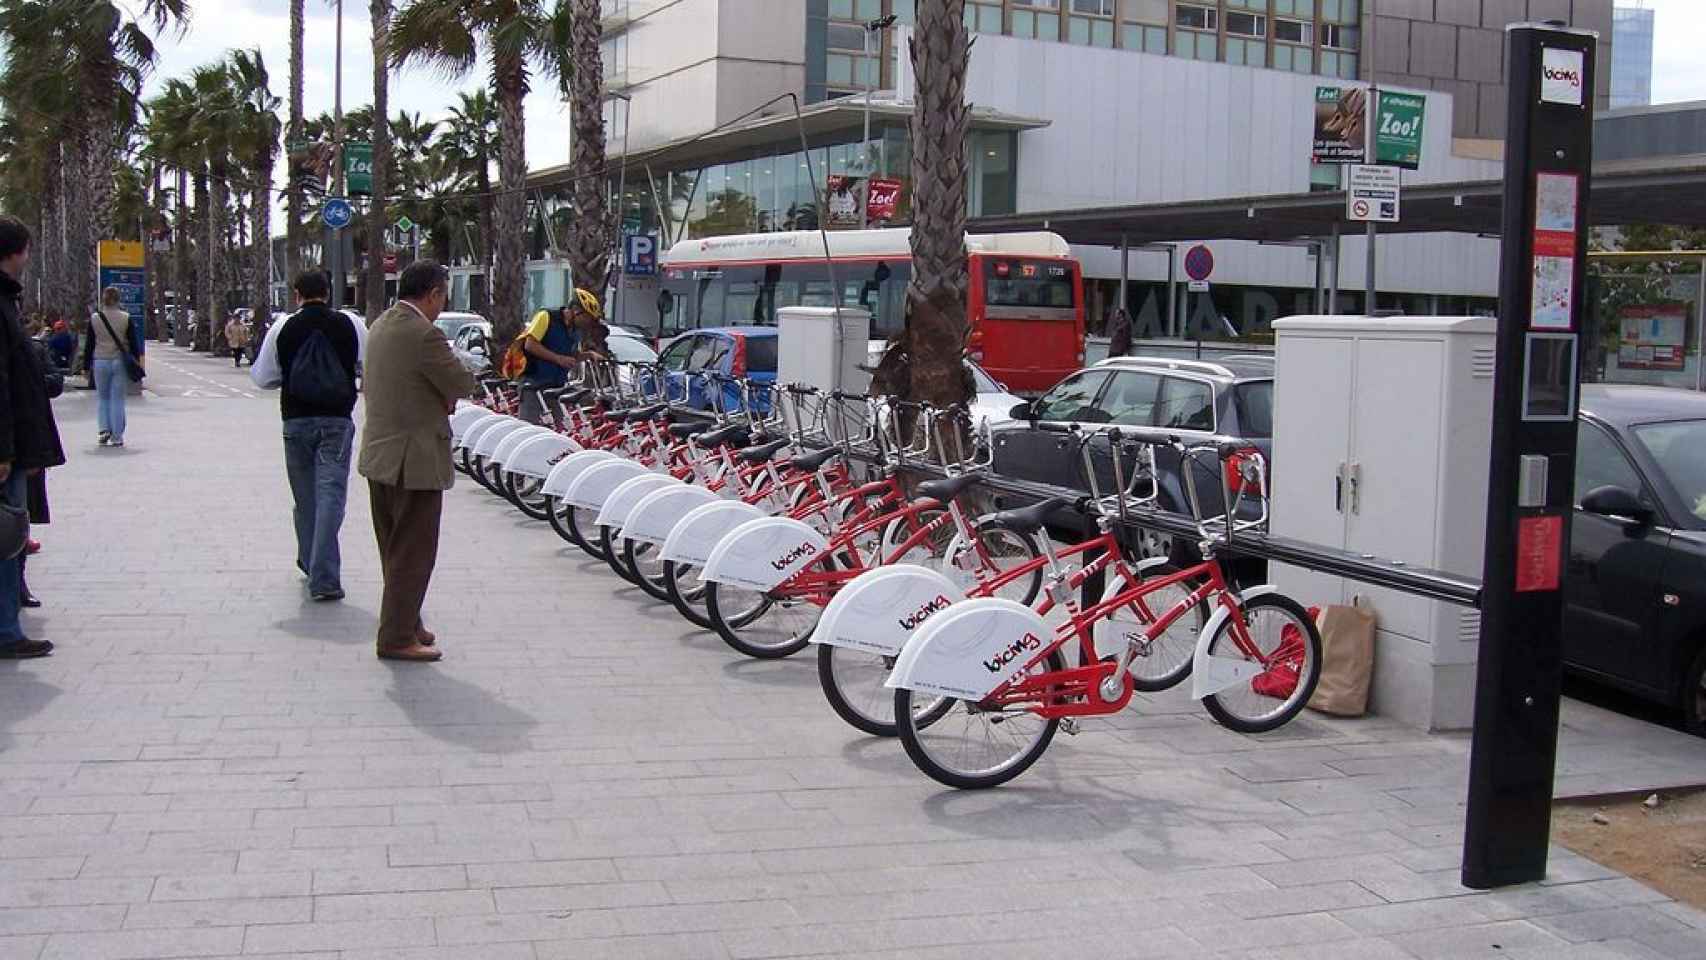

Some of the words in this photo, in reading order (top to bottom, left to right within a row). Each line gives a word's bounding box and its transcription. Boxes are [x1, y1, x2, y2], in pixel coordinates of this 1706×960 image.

[1543, 65, 1580, 87] bicing
[1379, 112, 1421, 137] Zoo!
[631, 236, 652, 264] P
[771, 541, 816, 570] bicing
[899, 594, 952, 631] bicing
[983, 632, 1041, 673] bicing
